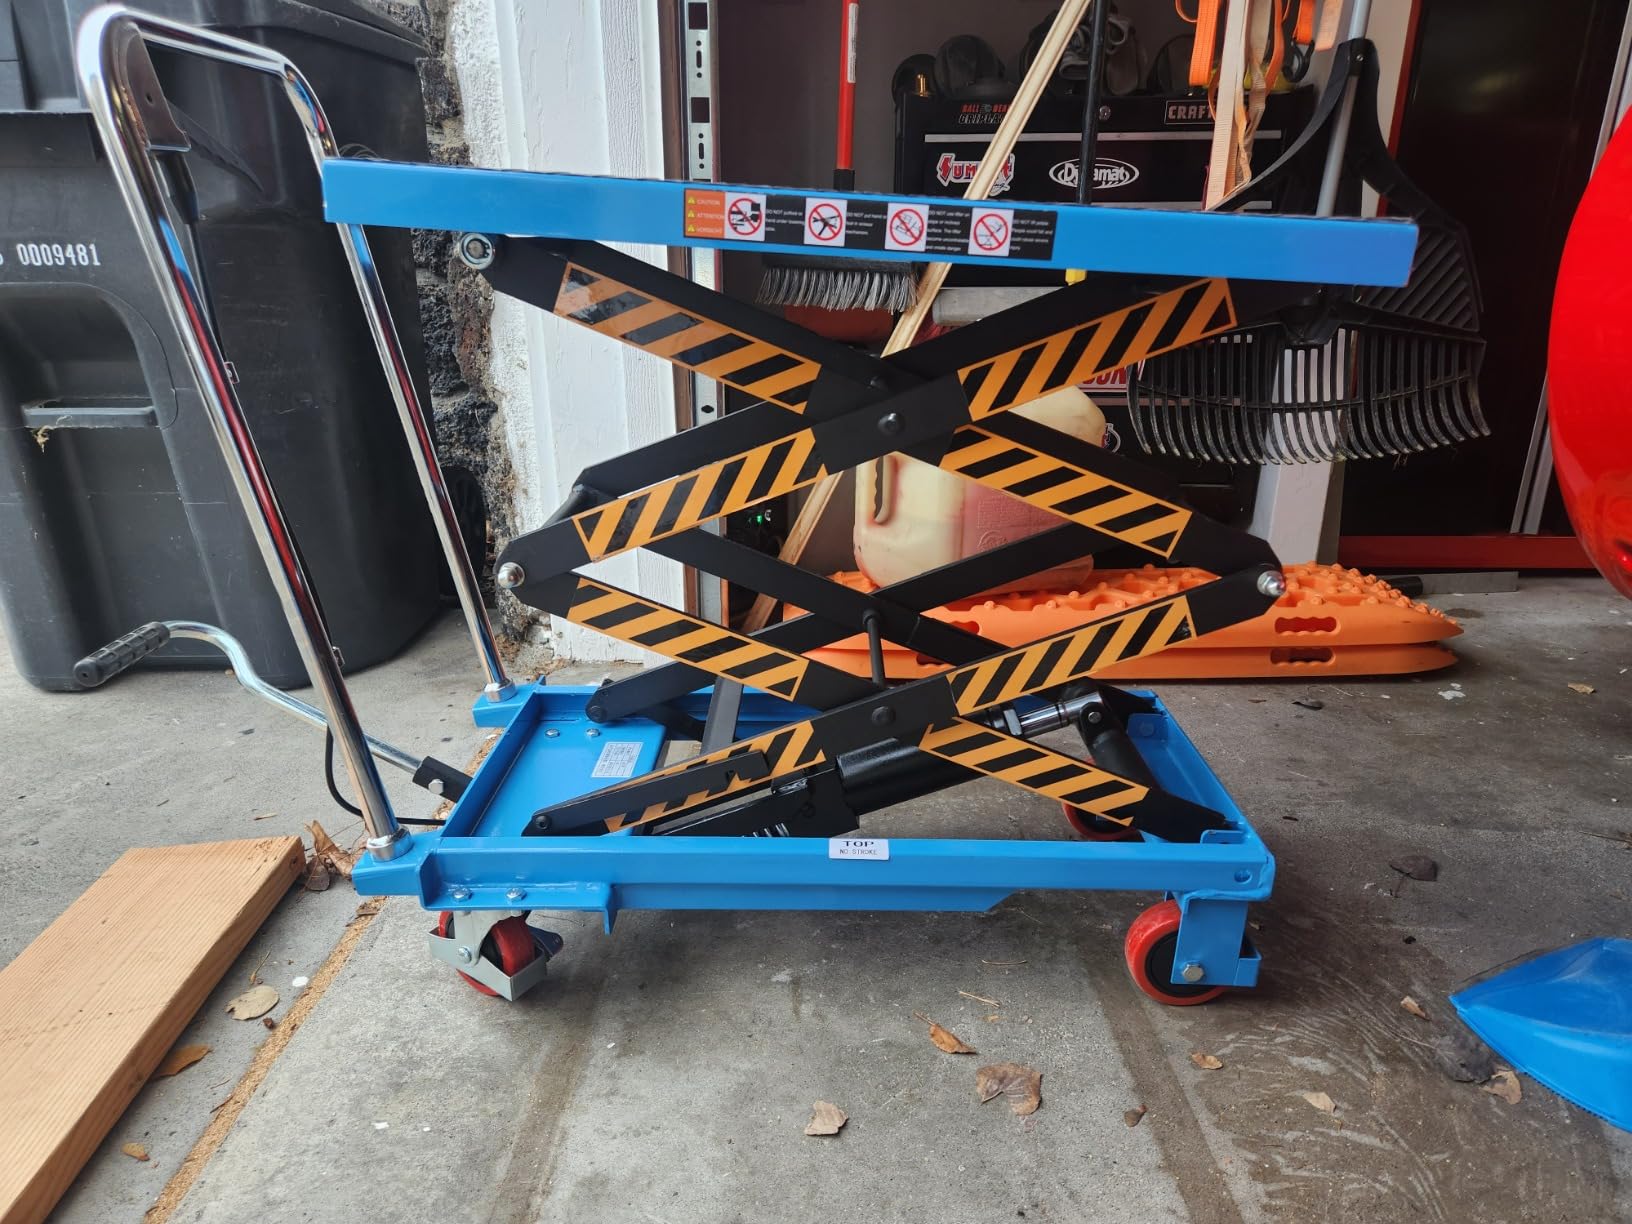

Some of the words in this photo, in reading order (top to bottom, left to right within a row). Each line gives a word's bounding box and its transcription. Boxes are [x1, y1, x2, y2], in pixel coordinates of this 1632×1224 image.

[1168, 105, 1213, 120] CRAFT
[1064, 163, 1124, 186] Dyamat
[16, 243, 101, 266] 0009481
